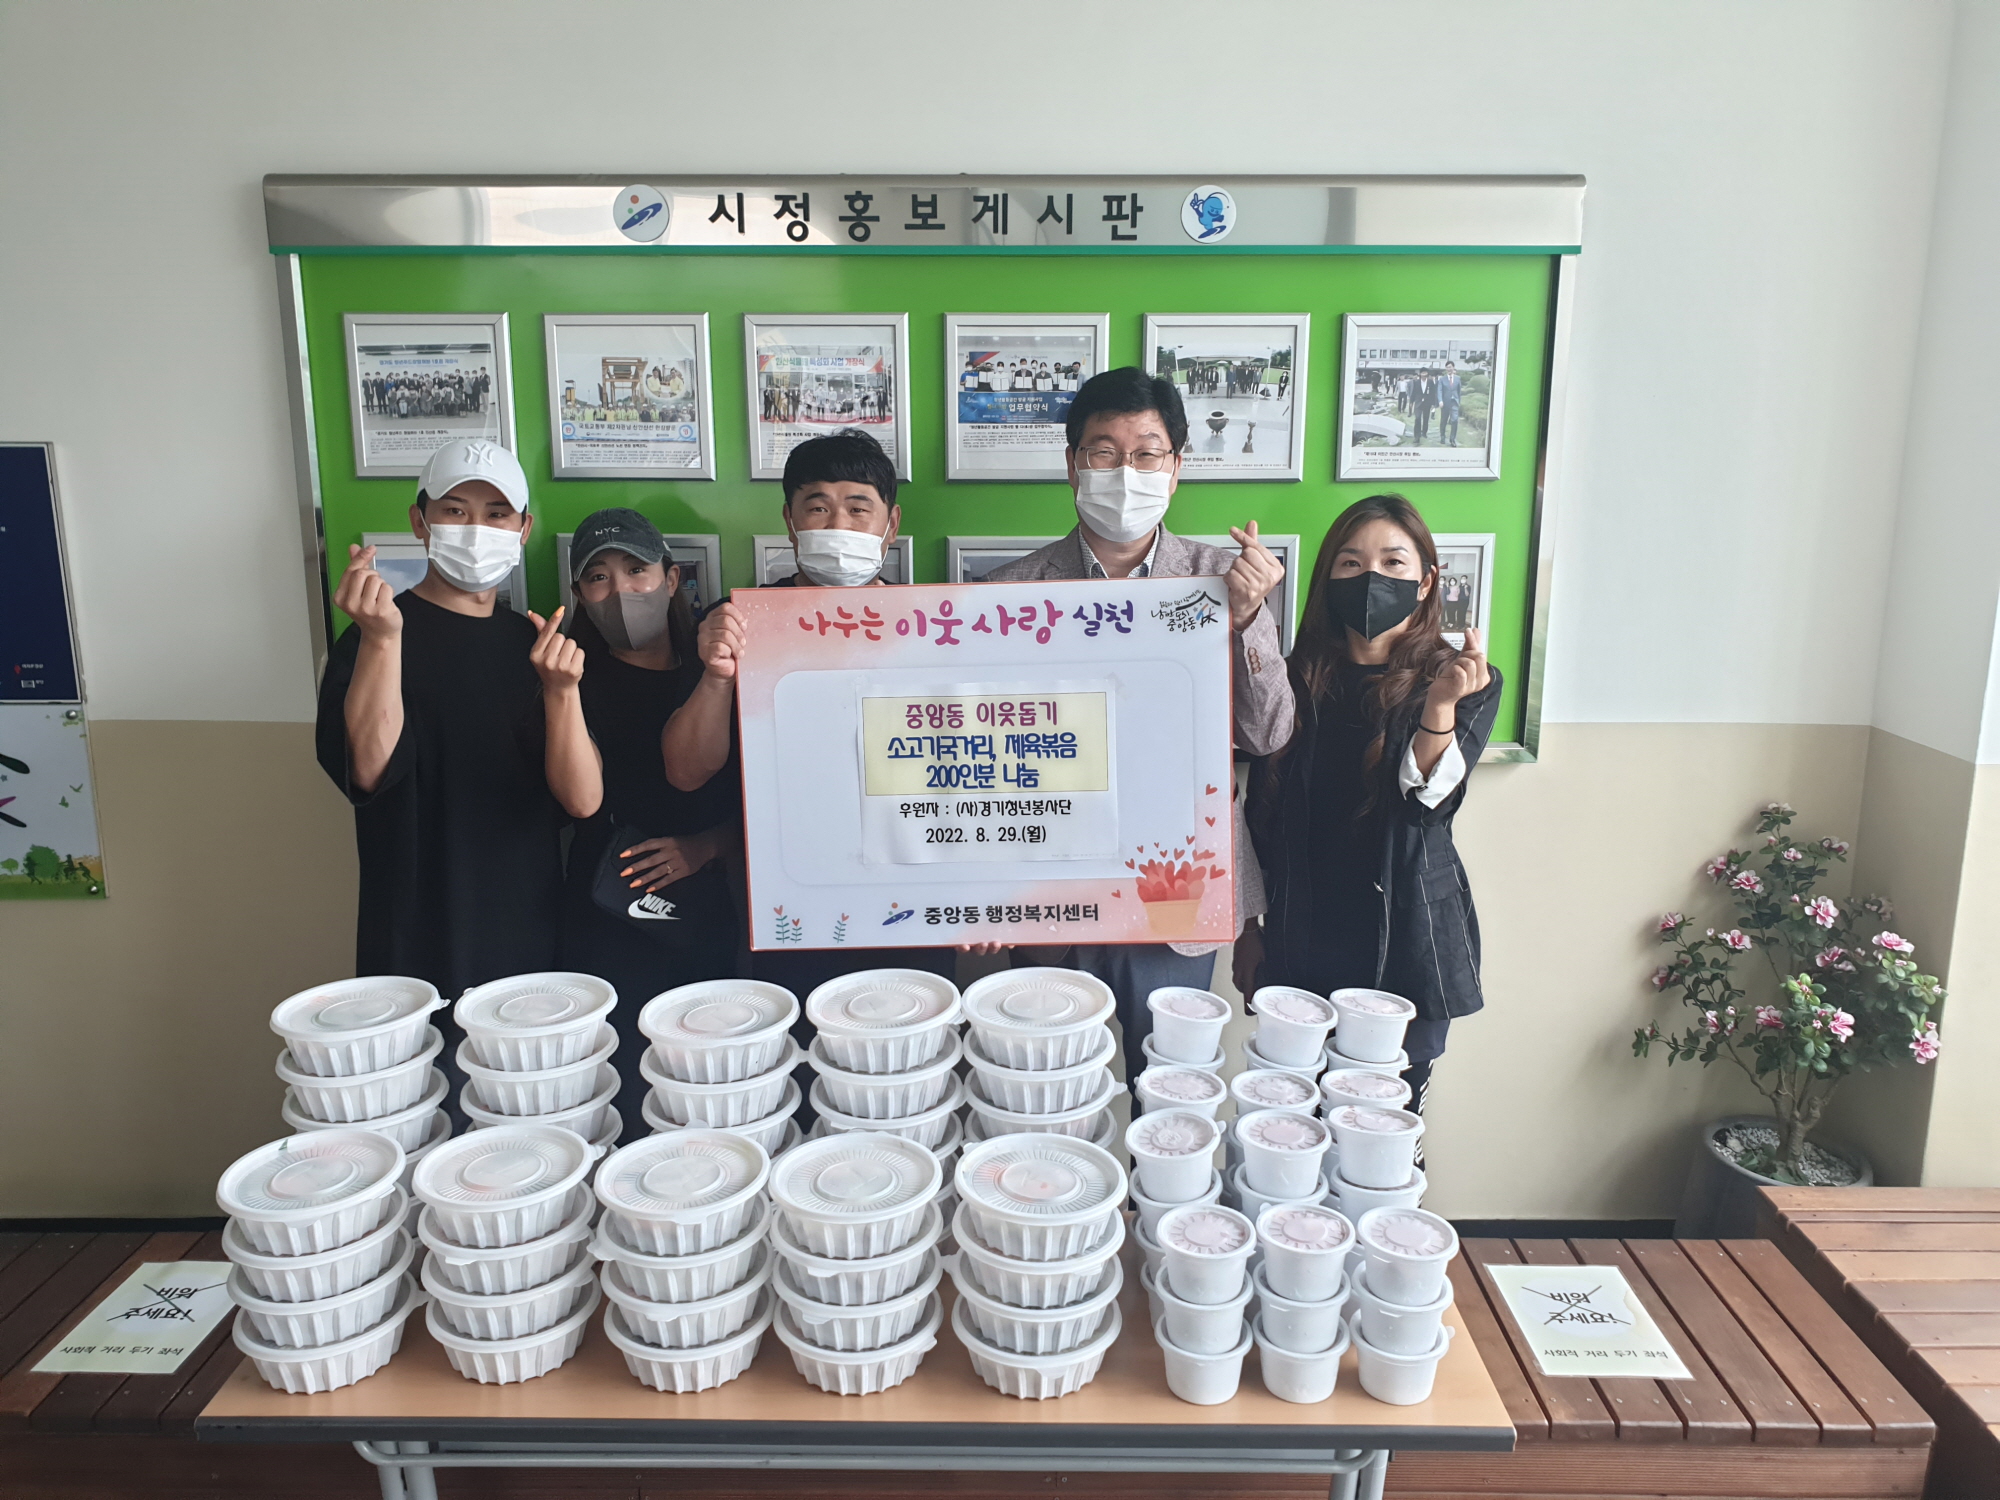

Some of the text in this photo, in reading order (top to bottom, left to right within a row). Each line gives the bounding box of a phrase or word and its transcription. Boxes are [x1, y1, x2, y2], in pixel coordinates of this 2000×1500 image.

[1009, 403, 1048, 412] 업무협약식
[595, 526, 620, 536] NYC
[798, 599, 1134, 646] 나누는 이웃 사랑 실천
[1167, 616, 1197, 632] 중앙동
[905, 700, 1058, 730] 중앙동 이웃돕기
[887, 731, 1078, 762] 소고기국거리, 제육볶음
[926, 763, 1040, 790] 200인분 나눔
[899, 802, 939, 818] 후원자
[956, 799, 1072, 817] (사)경기청년봉사단
[925, 825, 1047, 843] 2022. 8. 29.(월)
[638, 893, 677, 916] NIKE
[924, 903, 1099, 925] 중앙동 행정복지센터
[157, 1287, 198, 1299] 비워
[1549, 1292, 1591, 1304] 비워
[1548, 1311, 1618, 1324] 주세요!
[60, 1345, 185, 1356] 사회적 거리 두기 좌석
[1544, 1349, 1669, 1359] 사회적 거리 두기 좌석
